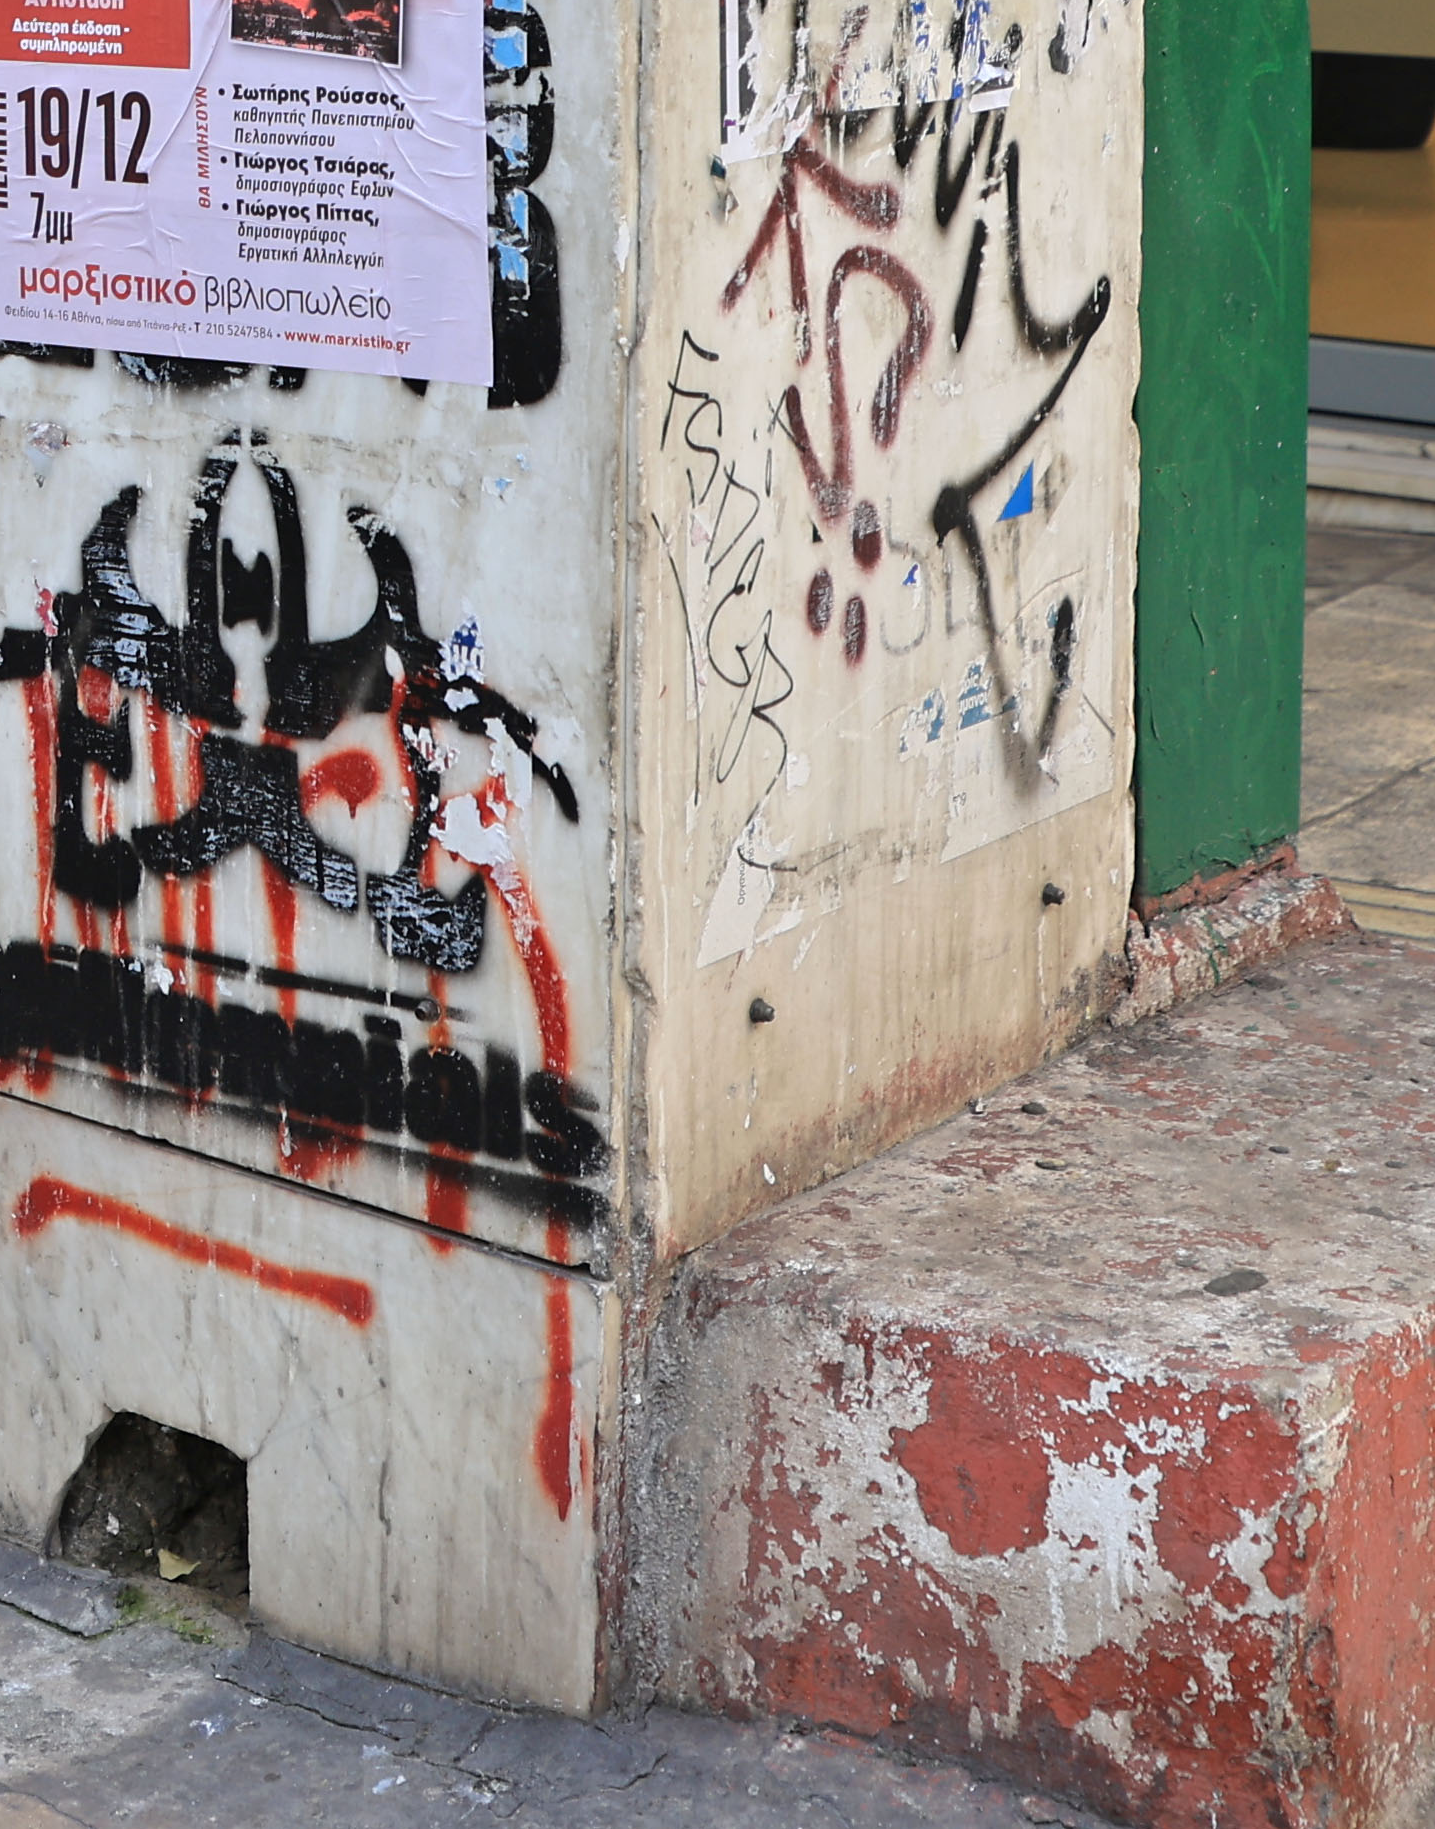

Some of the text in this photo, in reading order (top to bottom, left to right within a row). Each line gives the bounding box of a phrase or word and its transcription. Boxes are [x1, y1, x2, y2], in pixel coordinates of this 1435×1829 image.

[12, 17, 69, 36] Δεύτερη
[71, 18, 122, 37] έκδοση
[19, 37, 123, 56] συμπληρωμένη
[232, 83, 406, 112] Σωτήρης Ρούσσος,
[233, 106, 415, 131] καθηγητής Πανεπιστημίου
[17, 85, 152, 190] 19/12
[195, 85, 211, 209] ΘΑ ΜΙΛΗΣΟΥΝ
[234, 128, 335, 148] Πελοποννήσου
[234, 151, 395, 182] Γιώργος Τσιάρας,
[236, 174, 395, 200] δημοσιογράφος ΕφΣυν
[29, 190, 74, 245] 7μμ
[236, 199, 380, 228] Γιώργος Πίττας,
[237, 221, 347, 247] δημοσιογράφος
[238, 242, 299, 264] Εργατική
[19, 264, 393, 321] μαρξιστικό βιβλιοπωλείο
[4, 304, 41, 320] Φειδίου
[41, 307, 70, 322] 14-16
[70, 309, 105, 327] Αθήνα,
[205, 323, 225, 337] 210
[227, 325, 274, 340] 5247584
